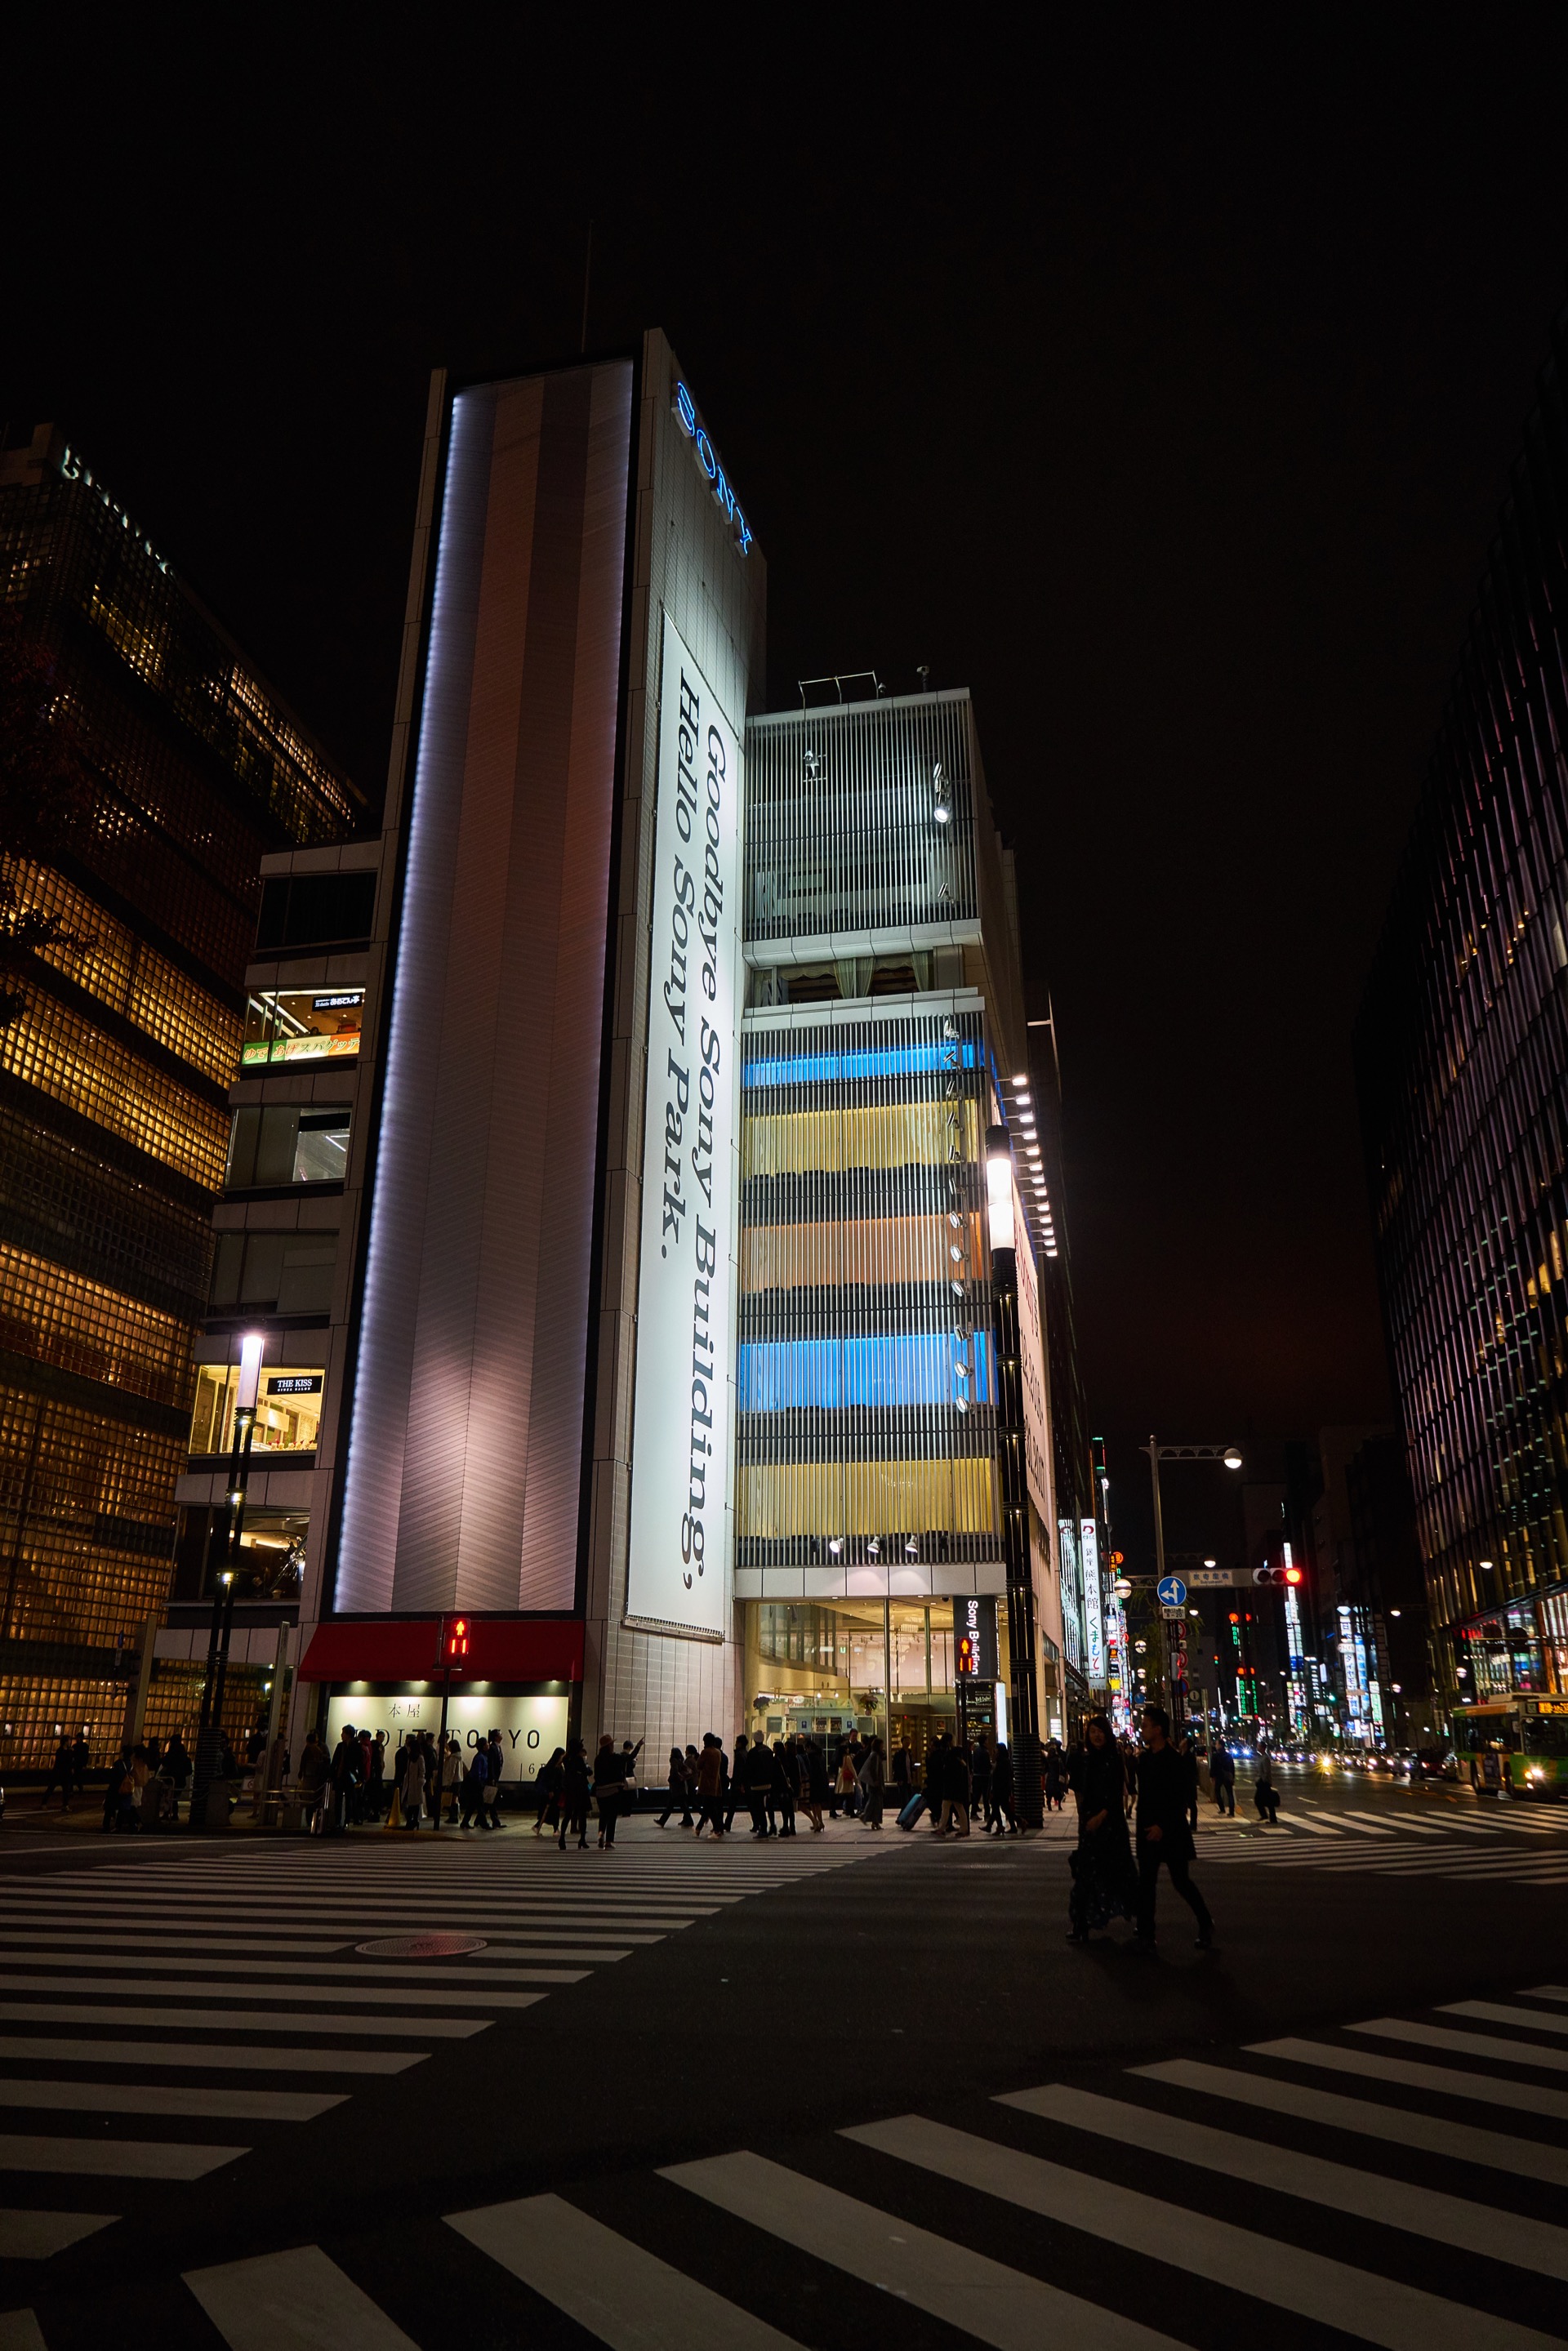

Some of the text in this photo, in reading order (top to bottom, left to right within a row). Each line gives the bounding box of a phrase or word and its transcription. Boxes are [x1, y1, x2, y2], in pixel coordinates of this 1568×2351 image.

[677, 381, 752, 554] SONY
[662, 666, 700, 1259] Hello Sony Park.
[682, 725, 725, 1591] Goodbye Sony Building,
[295, 1378, 312, 1387] KISS
[966, 1600, 978, 1628] Sony
[1085, 1547, 1100, 1670] 銀座熊本館 くまもと
[388, 1703, 421, 1718] 本屋
[446, 1729, 540, 1749] TOYO
